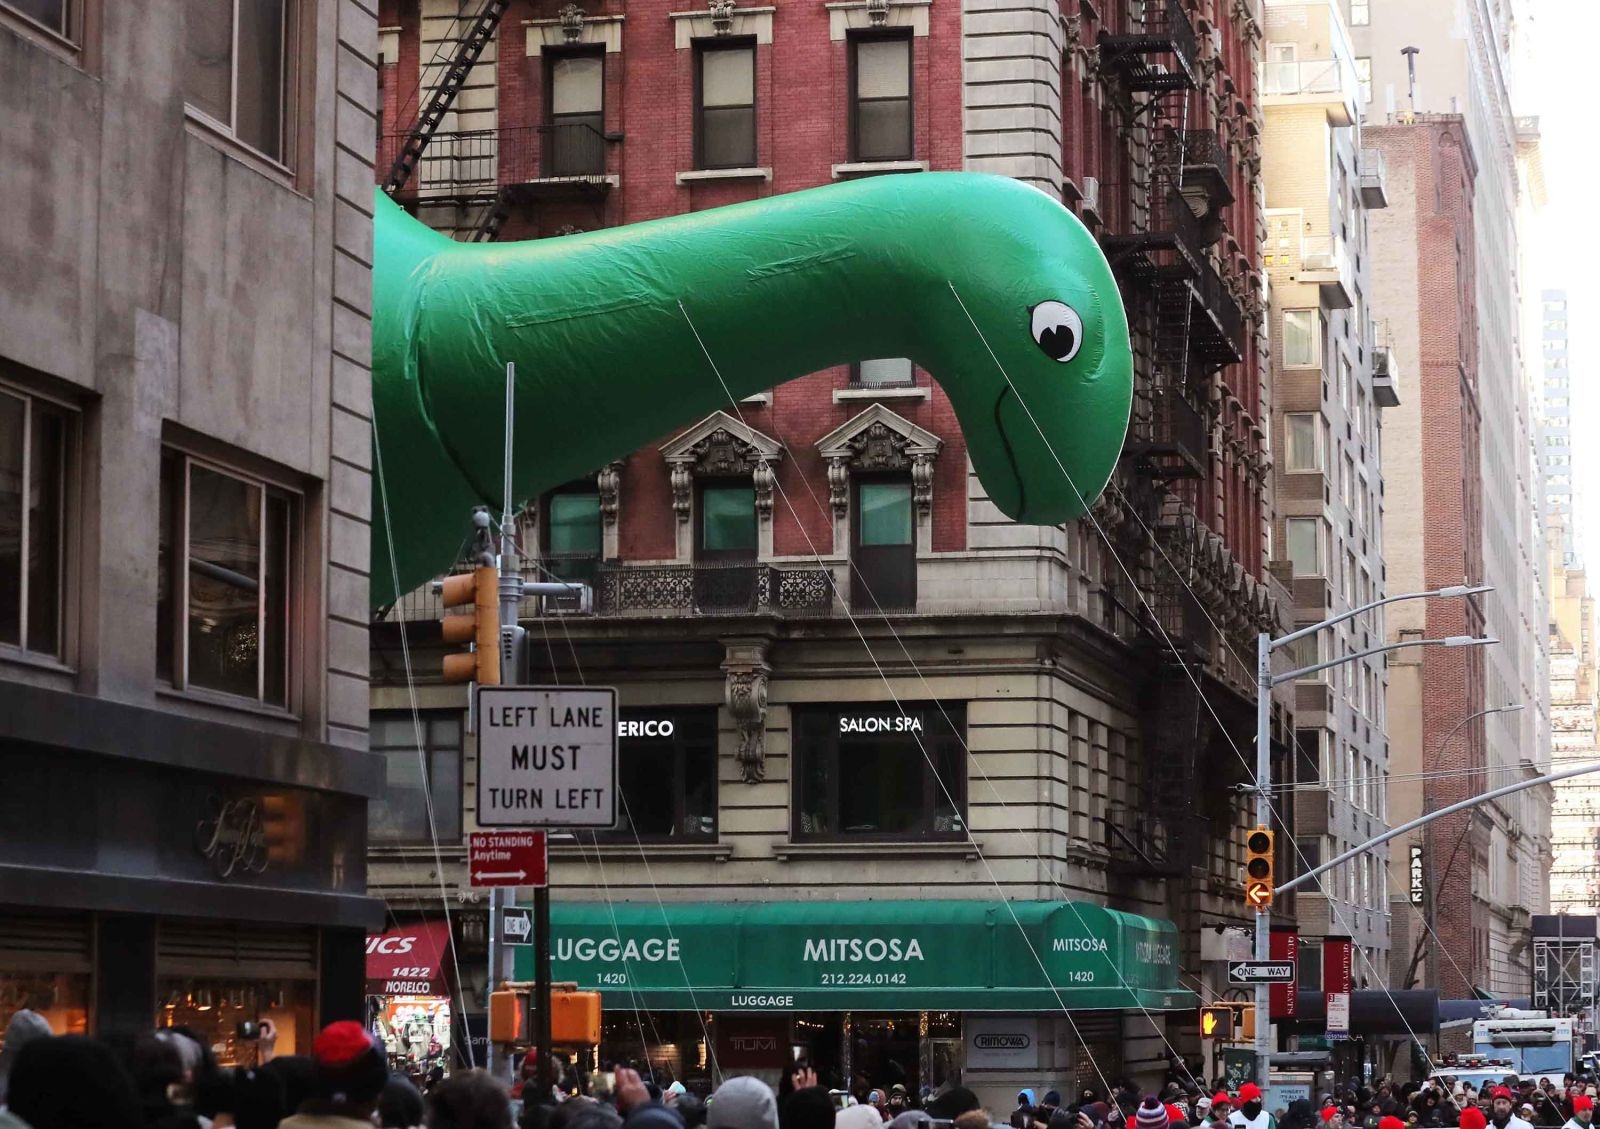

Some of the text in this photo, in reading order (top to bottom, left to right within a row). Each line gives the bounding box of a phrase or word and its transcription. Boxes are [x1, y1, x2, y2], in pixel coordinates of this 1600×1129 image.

[489, 706, 603, 728] LEFT LANE
[840, 716, 922, 732] SALON SPA
[618, 720, 674, 737] ERICO
[511, 744, 581, 771] MUST
[489, 788, 604, 809] TURN LEFT
[472, 836, 533, 848] NO STANDING
[473, 850, 512, 862] Anytime
[1410, 847, 1423, 888] PARK
[365, 936, 417, 954] ICS
[549, 938, 680, 962] UGGAGE
[803, 938, 924, 962] MITSOSA
[1052, 938, 1108, 952] MITSOSA
[1287, 936, 1295, 961] QUAL
[391, 967, 431, 978] 1422
[597, 973, 627, 985] 1420
[821, 973, 907, 985] 212.224.0142
[1069, 971, 1094, 982] 1420
[1237, 967, 1289, 977] ONE WAY
[385, 981, 431, 994] NORELCO
[731, 995, 794, 1007] LUGGAGE
[728, 1036, 777, 1051] TUMI
[981, 1036, 1025, 1047] RIMOWA
